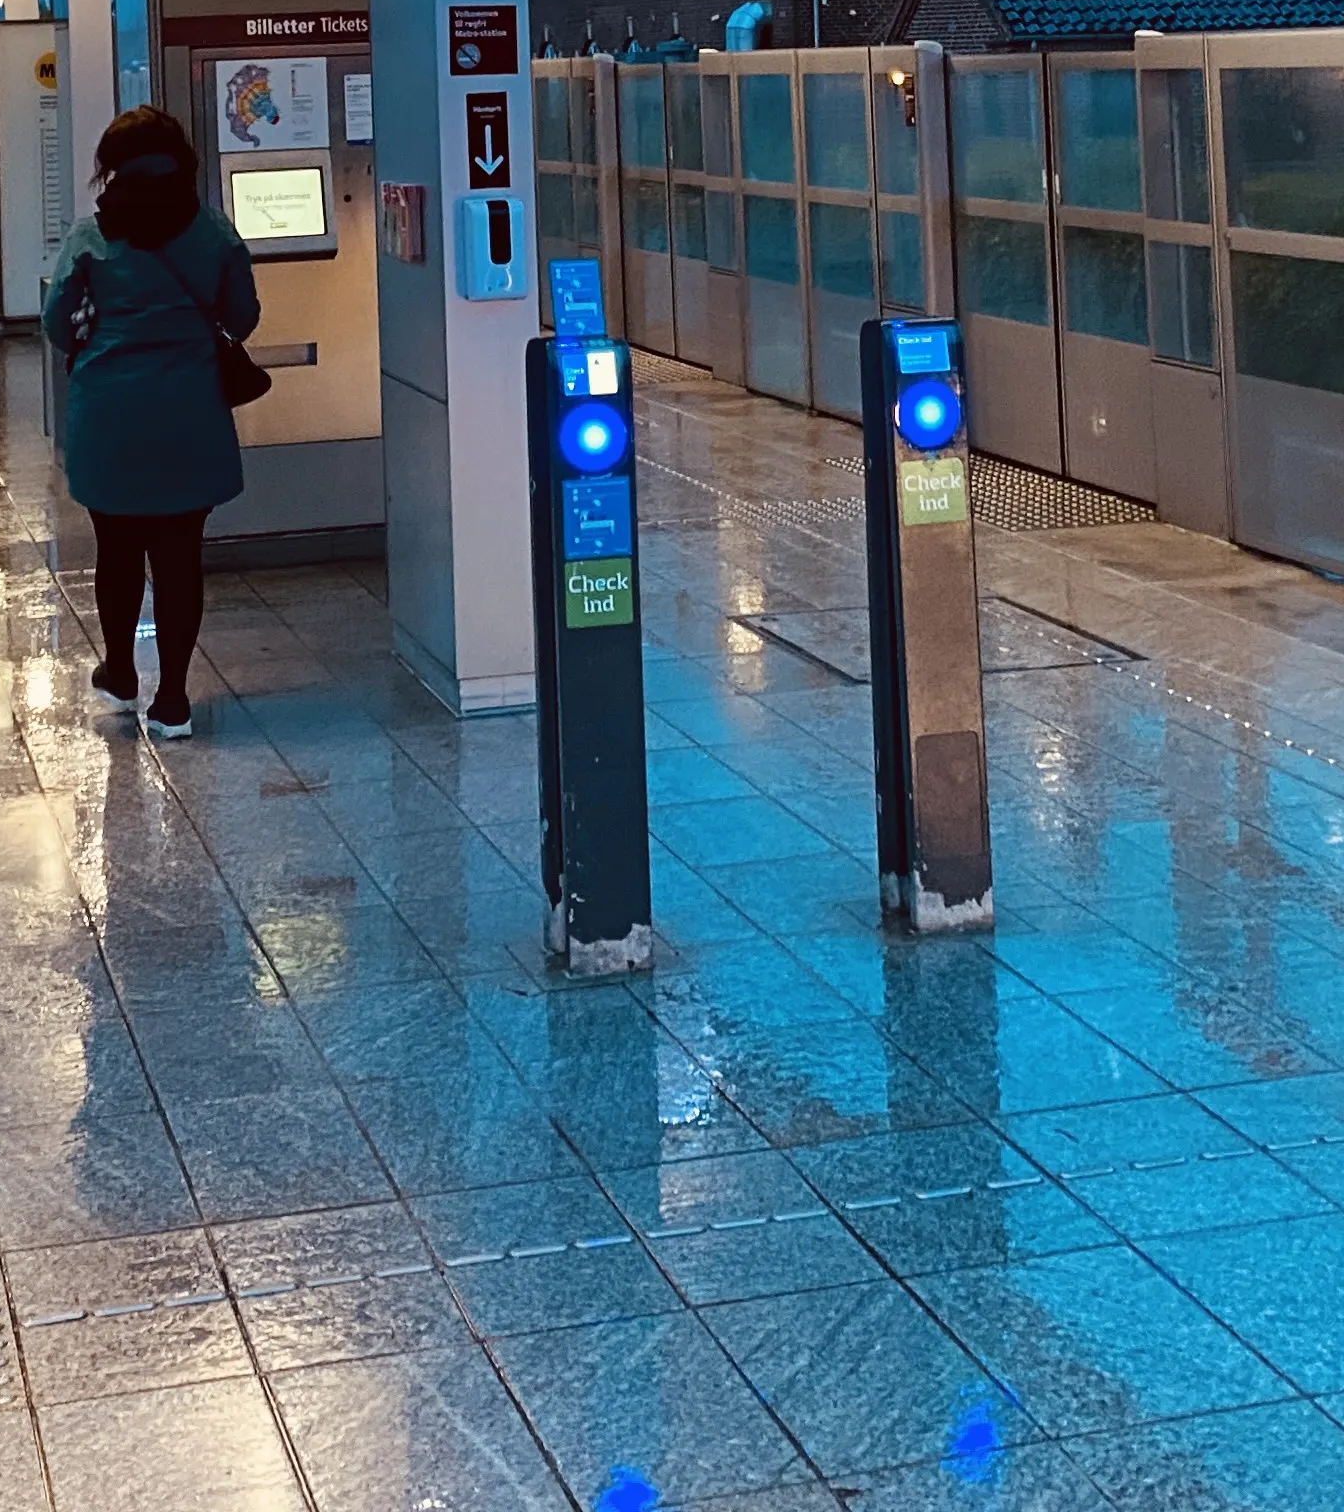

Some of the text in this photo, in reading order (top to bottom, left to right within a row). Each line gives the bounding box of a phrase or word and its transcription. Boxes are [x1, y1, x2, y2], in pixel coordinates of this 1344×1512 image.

[246, 15, 369, 35] Billetter Tickets
[39, 63, 56, 79] M
[904, 472, 961, 493] Check
[919, 493, 950, 512] ind
[568, 571, 629, 594] Check
[583, 594, 615, 614] ind
